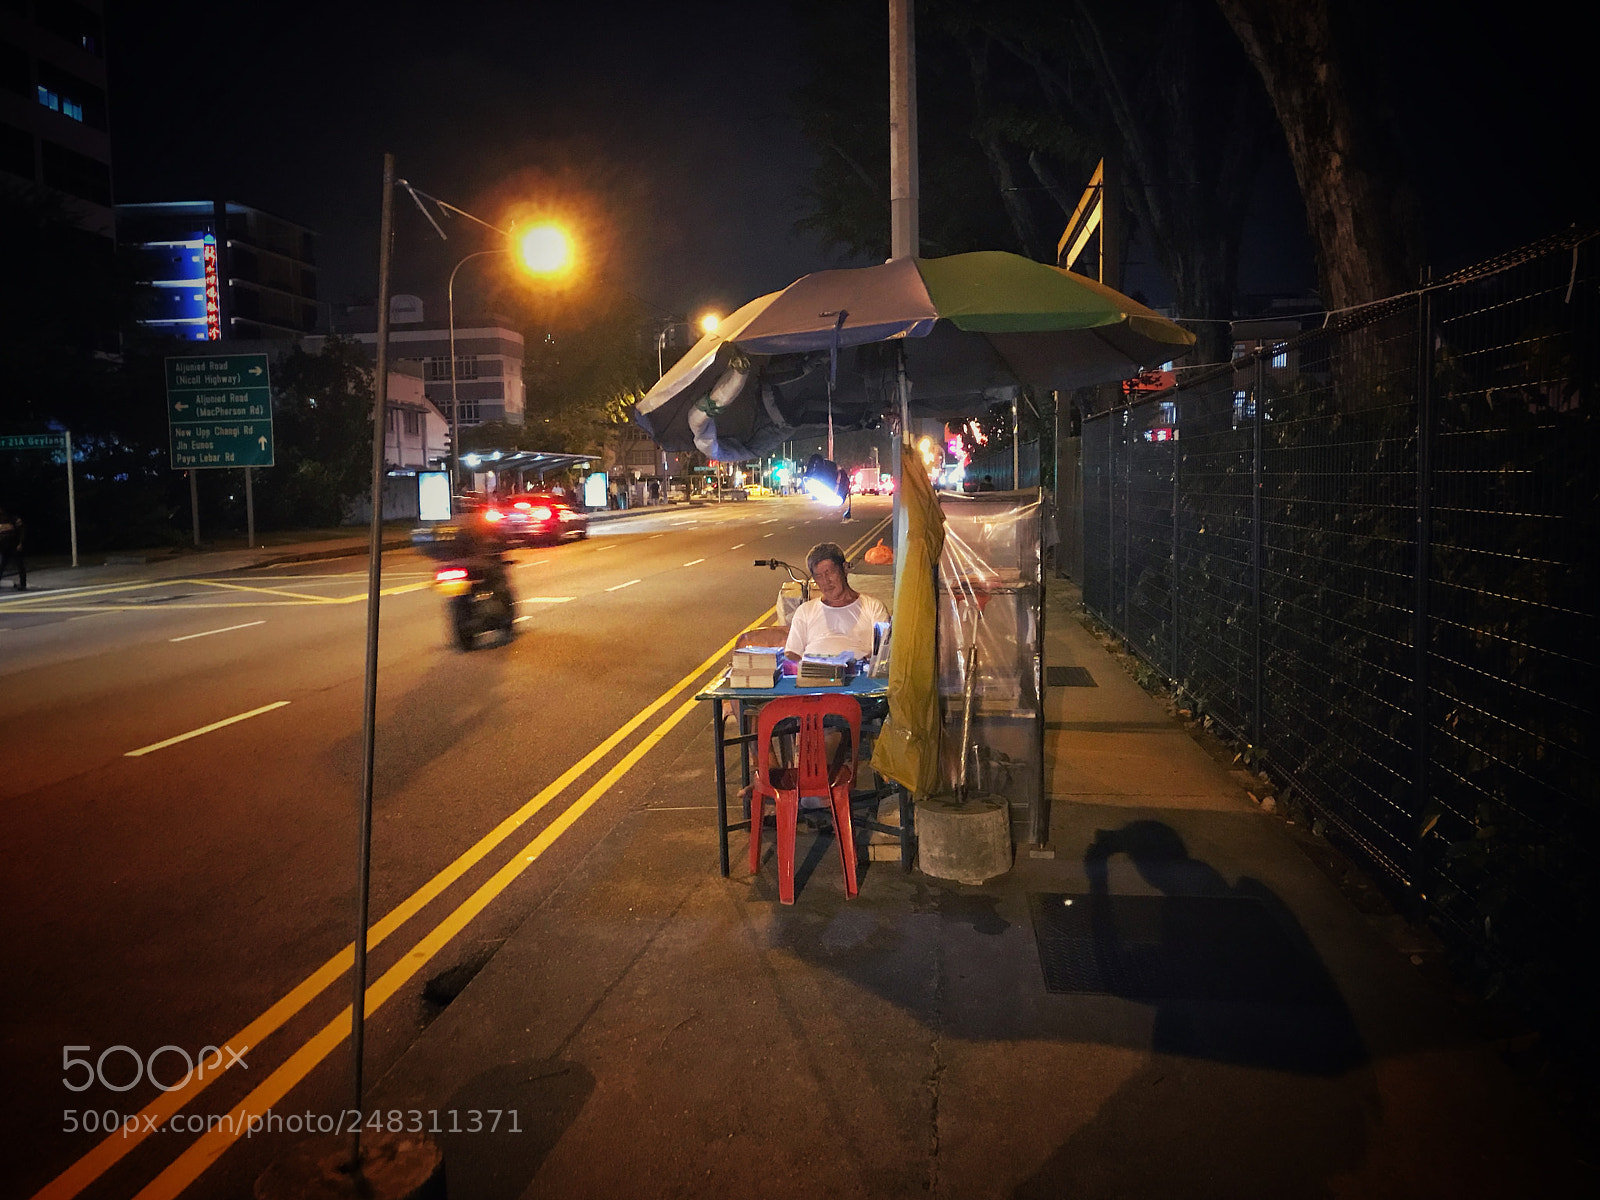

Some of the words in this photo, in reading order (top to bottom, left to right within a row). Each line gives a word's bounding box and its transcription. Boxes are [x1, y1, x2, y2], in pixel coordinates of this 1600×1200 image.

[175, 362, 206, 374] Aljunied
[209, 361, 228, 370] Road
[176, 374, 201, 385] (Nicoll
[204, 373, 241, 386] Highway)
[195, 394, 226, 405] Aljunied
[230, 392, 249, 402] Road
[196, 406, 246, 418] (MacPherson
[250, 404, 264, 416] Rd)
[175, 428, 192, 437] New
[195, 427, 210, 438] Upp
[214, 425, 240, 438] Changi
[243, 425, 254, 434] Rd
[8, 437, 25, 447] 21A
[28, 435, 65, 446] Geylang
[176, 441, 188, 450] Jln
[191, 440, 214, 450] Eunos
[176, 453, 196, 465] Paya
[199, 452, 220, 462] Lebar
[225, 452, 235, 462] Rd
